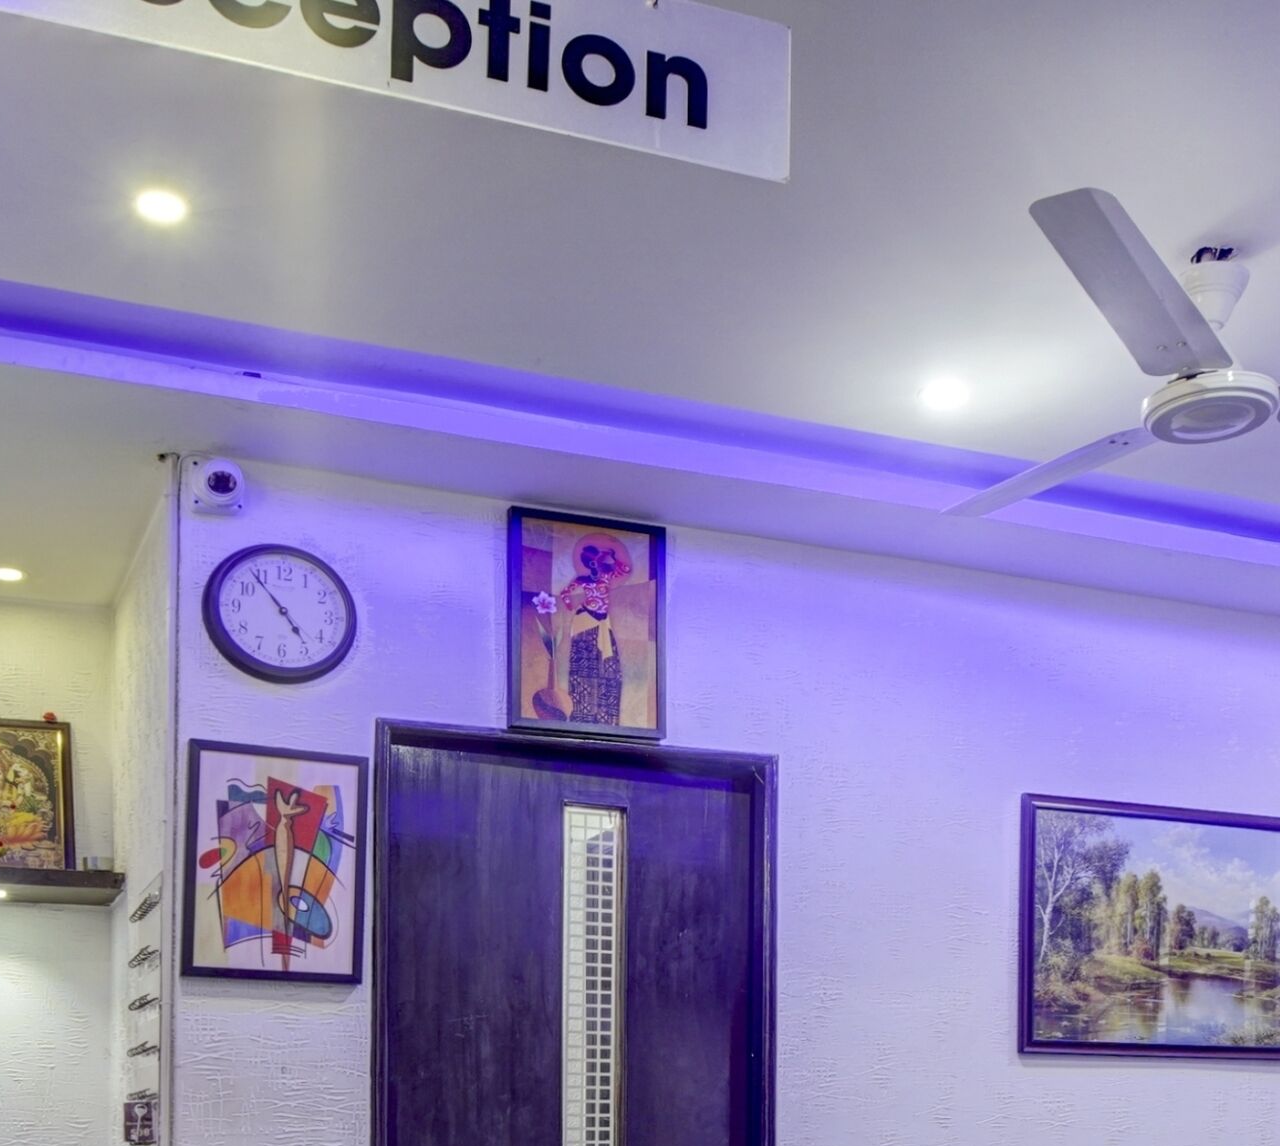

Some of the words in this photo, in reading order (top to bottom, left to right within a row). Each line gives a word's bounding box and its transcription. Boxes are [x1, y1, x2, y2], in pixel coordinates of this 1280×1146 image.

[140, 0, 708, 129] eption
[256, 569, 268, 584] 11
[276, 566, 293, 581] 12
[303, 573, 308, 589] 1
[240, 581, 256, 596] 10
[317, 589, 327, 604] 2
[231, 598, 241, 613] 9
[323, 610, 333, 625] 3
[238, 621, 249, 634] 8
[255, 635, 264, 650] 7
[314, 630, 324, 643] 4
[277, 643, 287, 658] 6
[299, 640, 309, 656] 5
